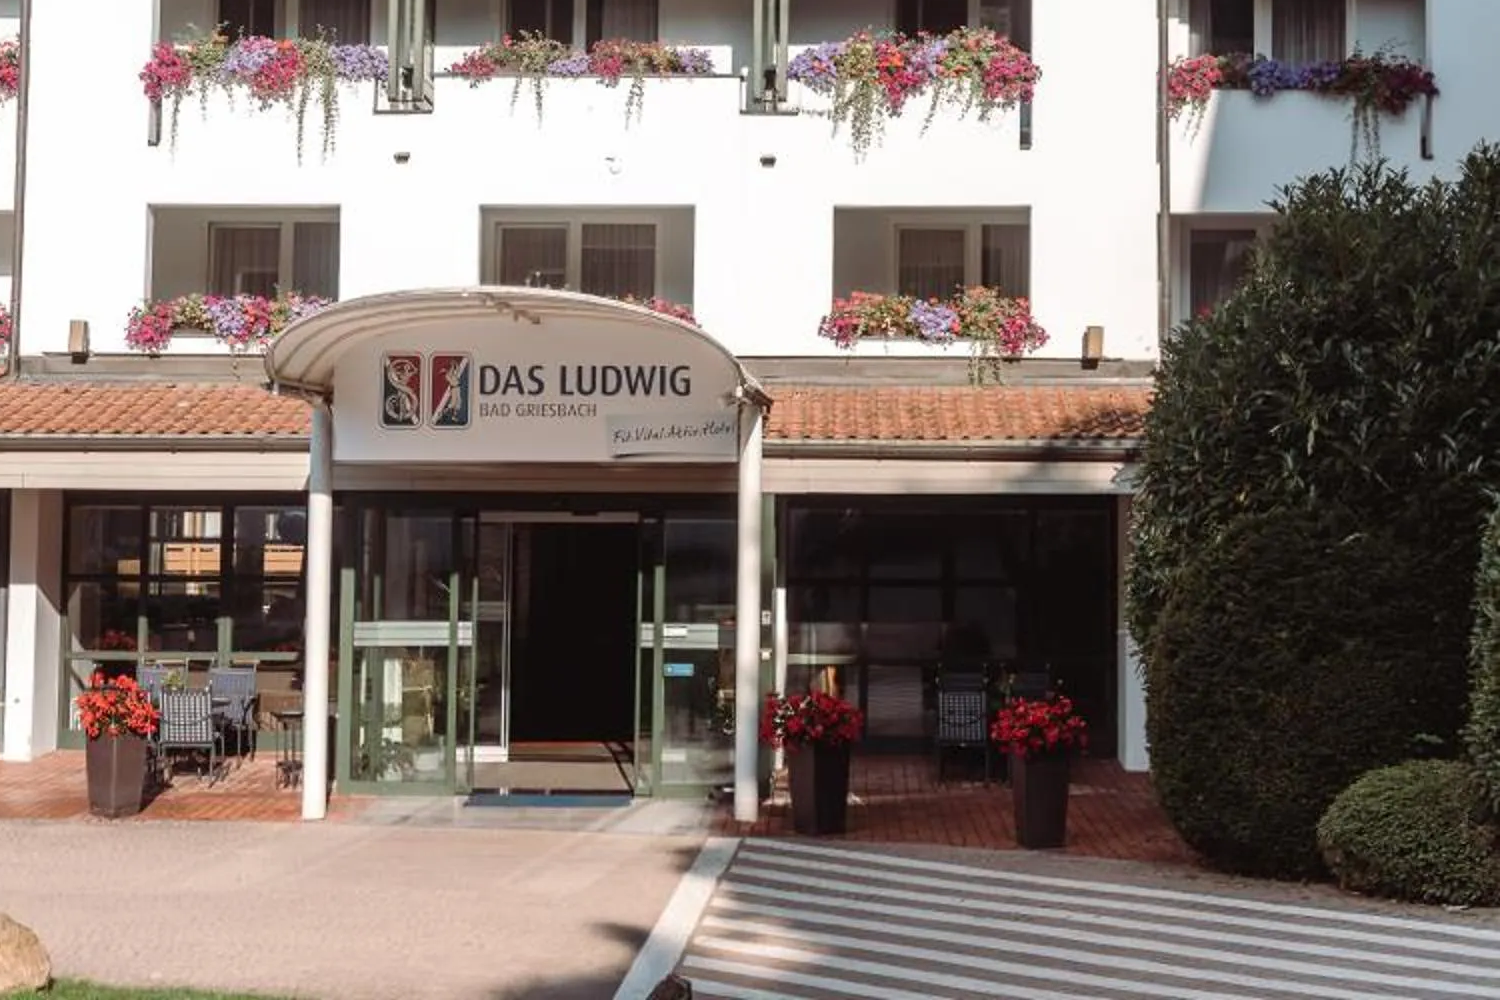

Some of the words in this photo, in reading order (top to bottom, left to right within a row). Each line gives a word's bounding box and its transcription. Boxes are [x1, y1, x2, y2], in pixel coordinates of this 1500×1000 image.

[479, 365, 545, 396] DAS
[559, 365, 691, 396] LUDWIG
[479, 403, 511, 418] BAD
[515, 403, 597, 418] GRIESBACH
